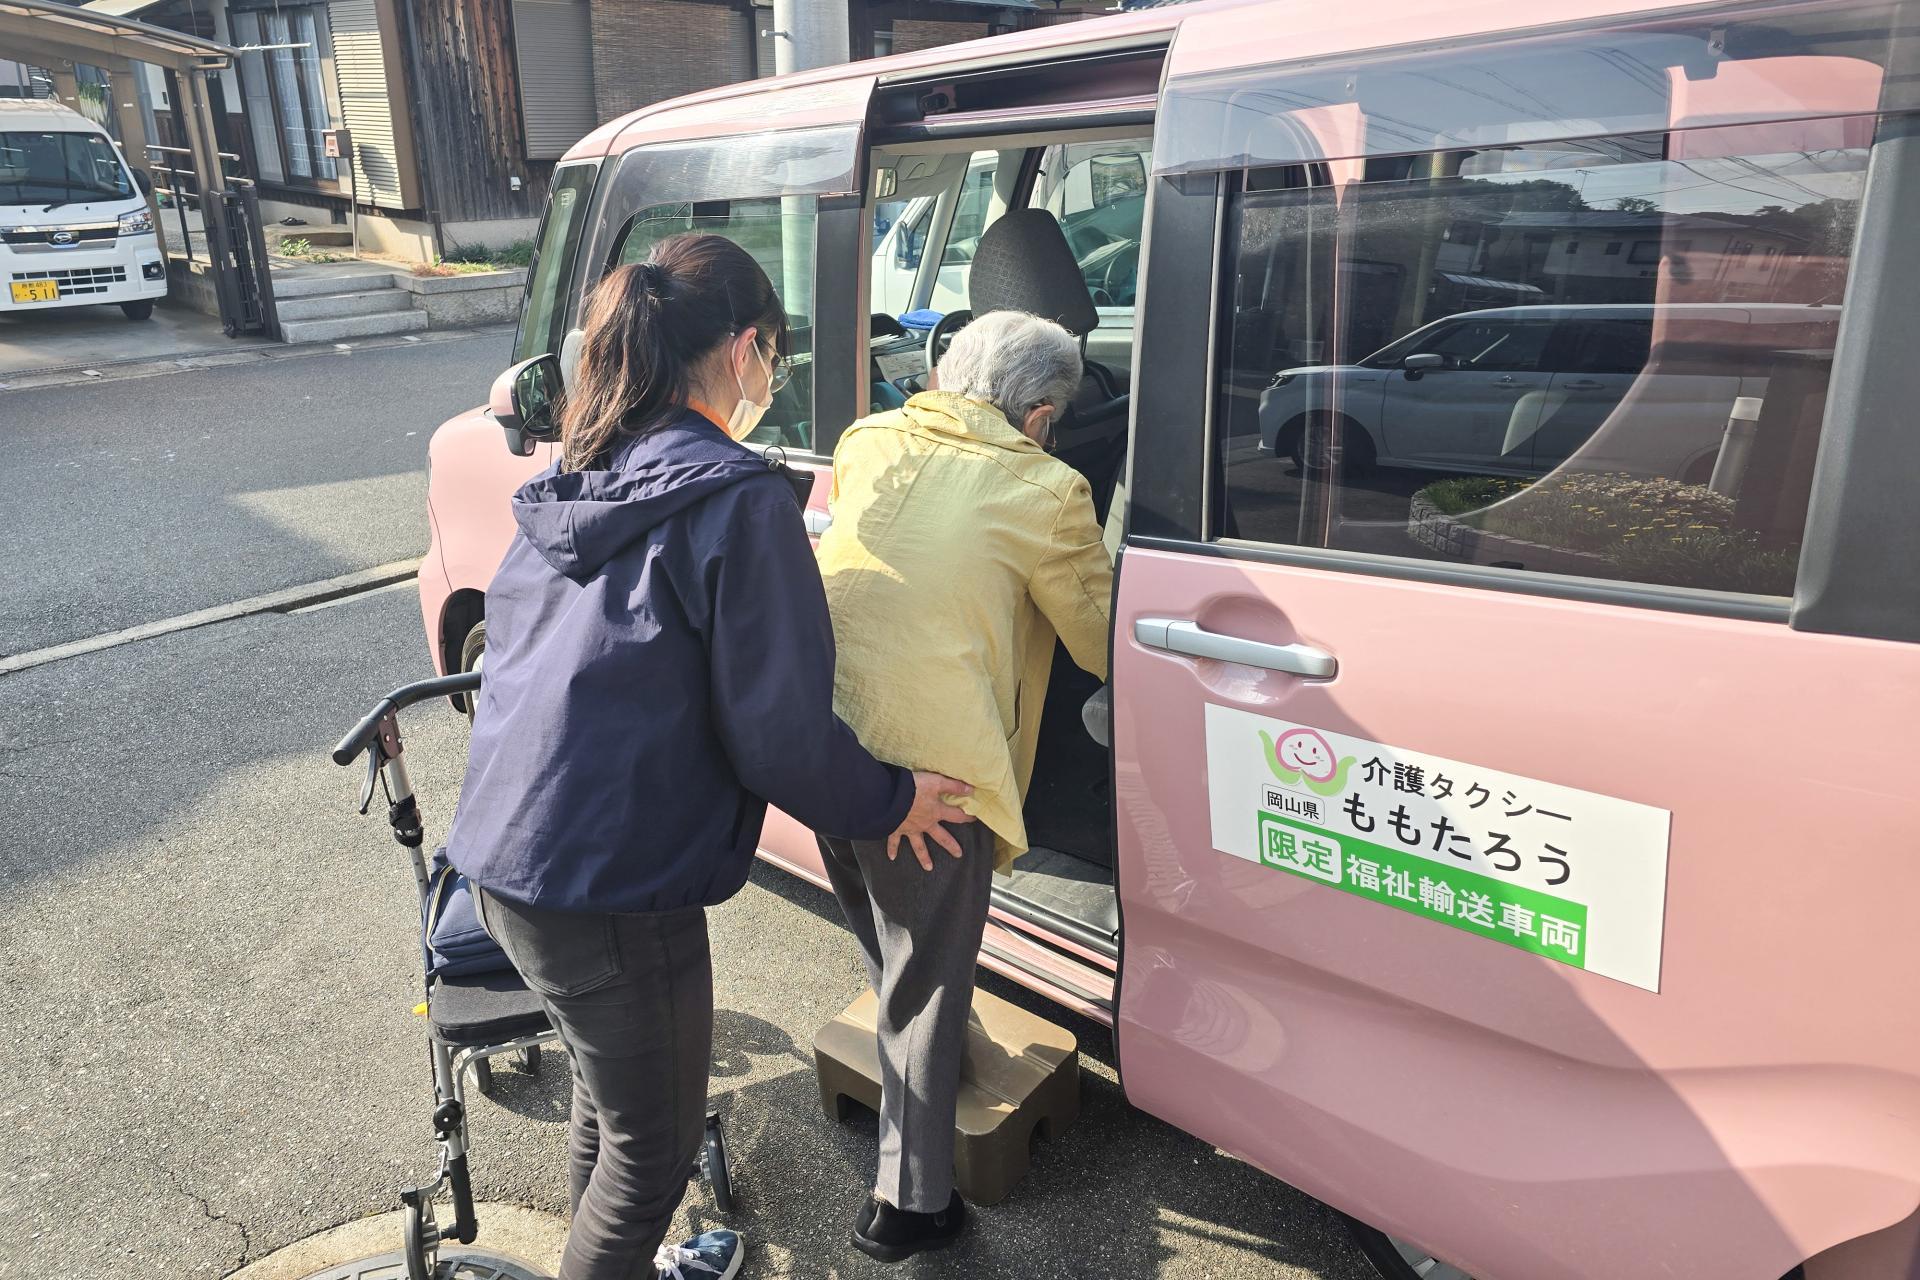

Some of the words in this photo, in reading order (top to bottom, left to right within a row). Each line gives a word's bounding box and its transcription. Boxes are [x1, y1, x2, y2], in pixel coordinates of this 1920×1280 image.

[1267, 790, 1320, 820] 岡山県
[1361, 756, 1572, 822] 介護タクシー
[1342, 792, 1571, 886] ももたろう
[1267, 827, 1334, 875] 限定
[1346, 854, 1581, 956] 福祉輸送車両
